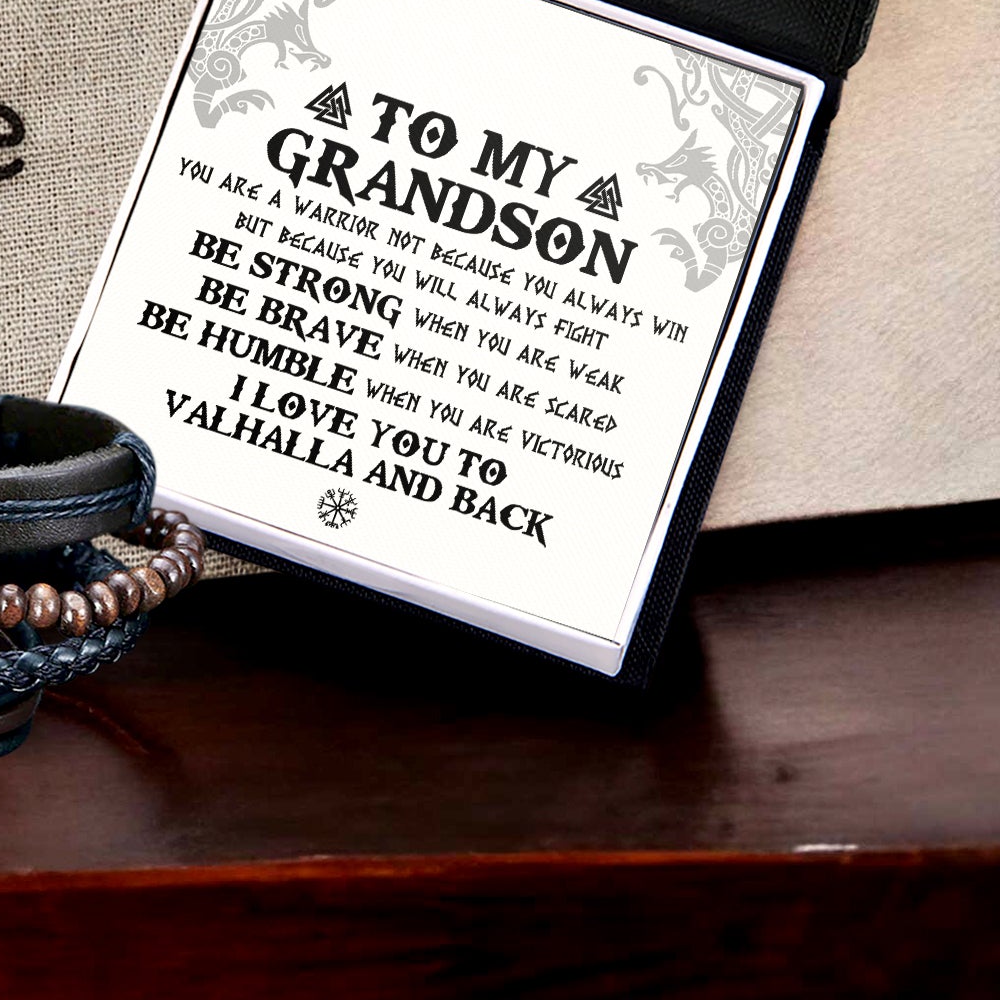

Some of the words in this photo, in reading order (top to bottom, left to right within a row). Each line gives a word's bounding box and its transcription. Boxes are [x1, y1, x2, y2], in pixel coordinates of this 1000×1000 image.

[267, 128, 638, 284] GRANDSON
[371, 93, 458, 159] TO
[471, 130, 578, 197] MY
[180, 157, 214, 184] YOU
[219, 173, 262, 200] ARE
[268, 189, 280, 208] A
[296, 195, 379, 240] WARRIOR
[387, 228, 425, 254] NOT
[431, 243, 515, 285] BECAUSE
[524, 273, 557, 299] YOU
[563, 288, 643, 327] ALWAYS
[654, 316, 688, 343] WIN
[189, 230, 242, 270] BE
[249, 252, 402, 329] STRONG
[416, 308, 469, 341] WHEN
[478, 329, 511, 355] YOU
[517, 345, 559, 372] ARE
[570, 360, 624, 394] WEAK
[235, 212, 273, 237] BUT
[278, 226, 363, 269] BECAUSE
[373, 256, 406, 282] YOU
[416, 270, 456, 301] WILL
[466, 290, 547, 329] ALWAYS
[554, 319, 609, 349] FIGHT
[137, 300, 192, 340] BE
[197, 320, 357, 395] HUMBLE
[367, 378, 421, 412] WHEN
[430, 400, 464, 426] YOU
[469, 415, 512, 443] ARE
[523, 430, 624, 479] VICTORIOUS
[195, 275, 249, 315] BE
[256, 295, 384, 360] BRAVE
[395, 344, 448, 378] WHEN
[457, 365, 490, 392] YOU
[496, 381, 539, 408] ARE
[545, 397, 617, 433] SCARED
[229, 375, 247, 401] I
[251, 381, 358, 439] LOVE
[371, 419, 450, 465] YOU
[458, 448, 507, 486] TO
[167, 389, 353, 477] VALHALLA
[363, 460, 442, 502] AND
[449, 485, 553, 547] BACK
